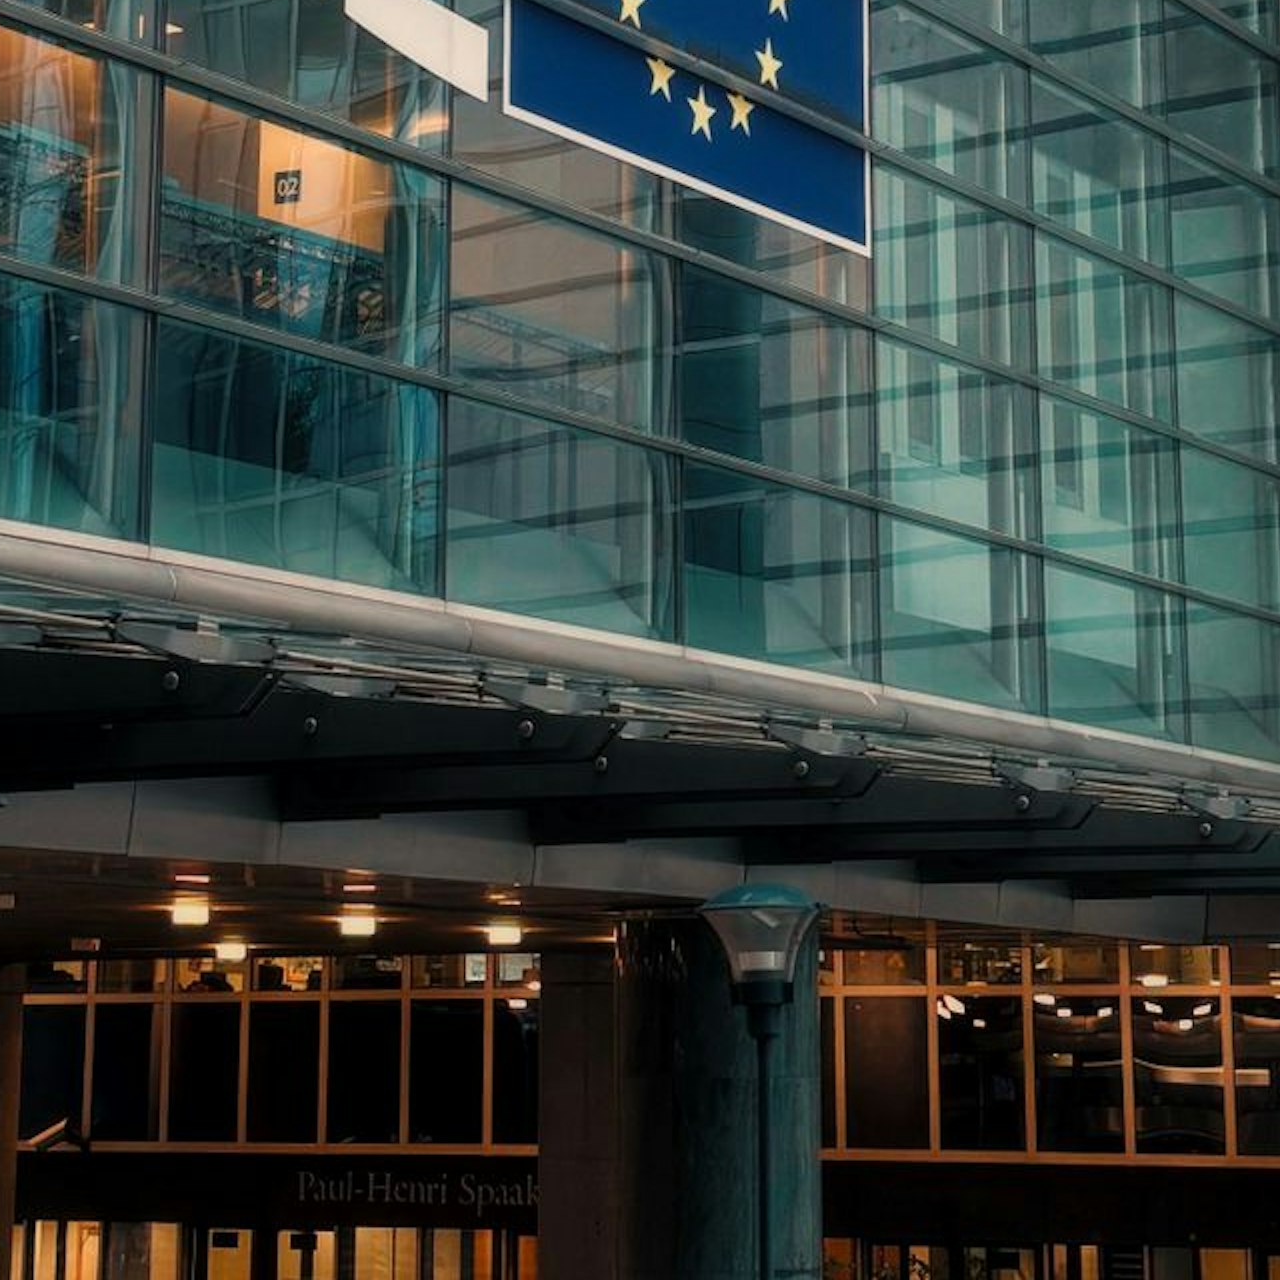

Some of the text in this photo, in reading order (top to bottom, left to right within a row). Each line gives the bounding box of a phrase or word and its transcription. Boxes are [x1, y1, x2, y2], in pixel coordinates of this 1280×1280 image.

[277, 177, 299, 197] 02
[296, 1171, 543, 1217] Paul-Henri Spaak
